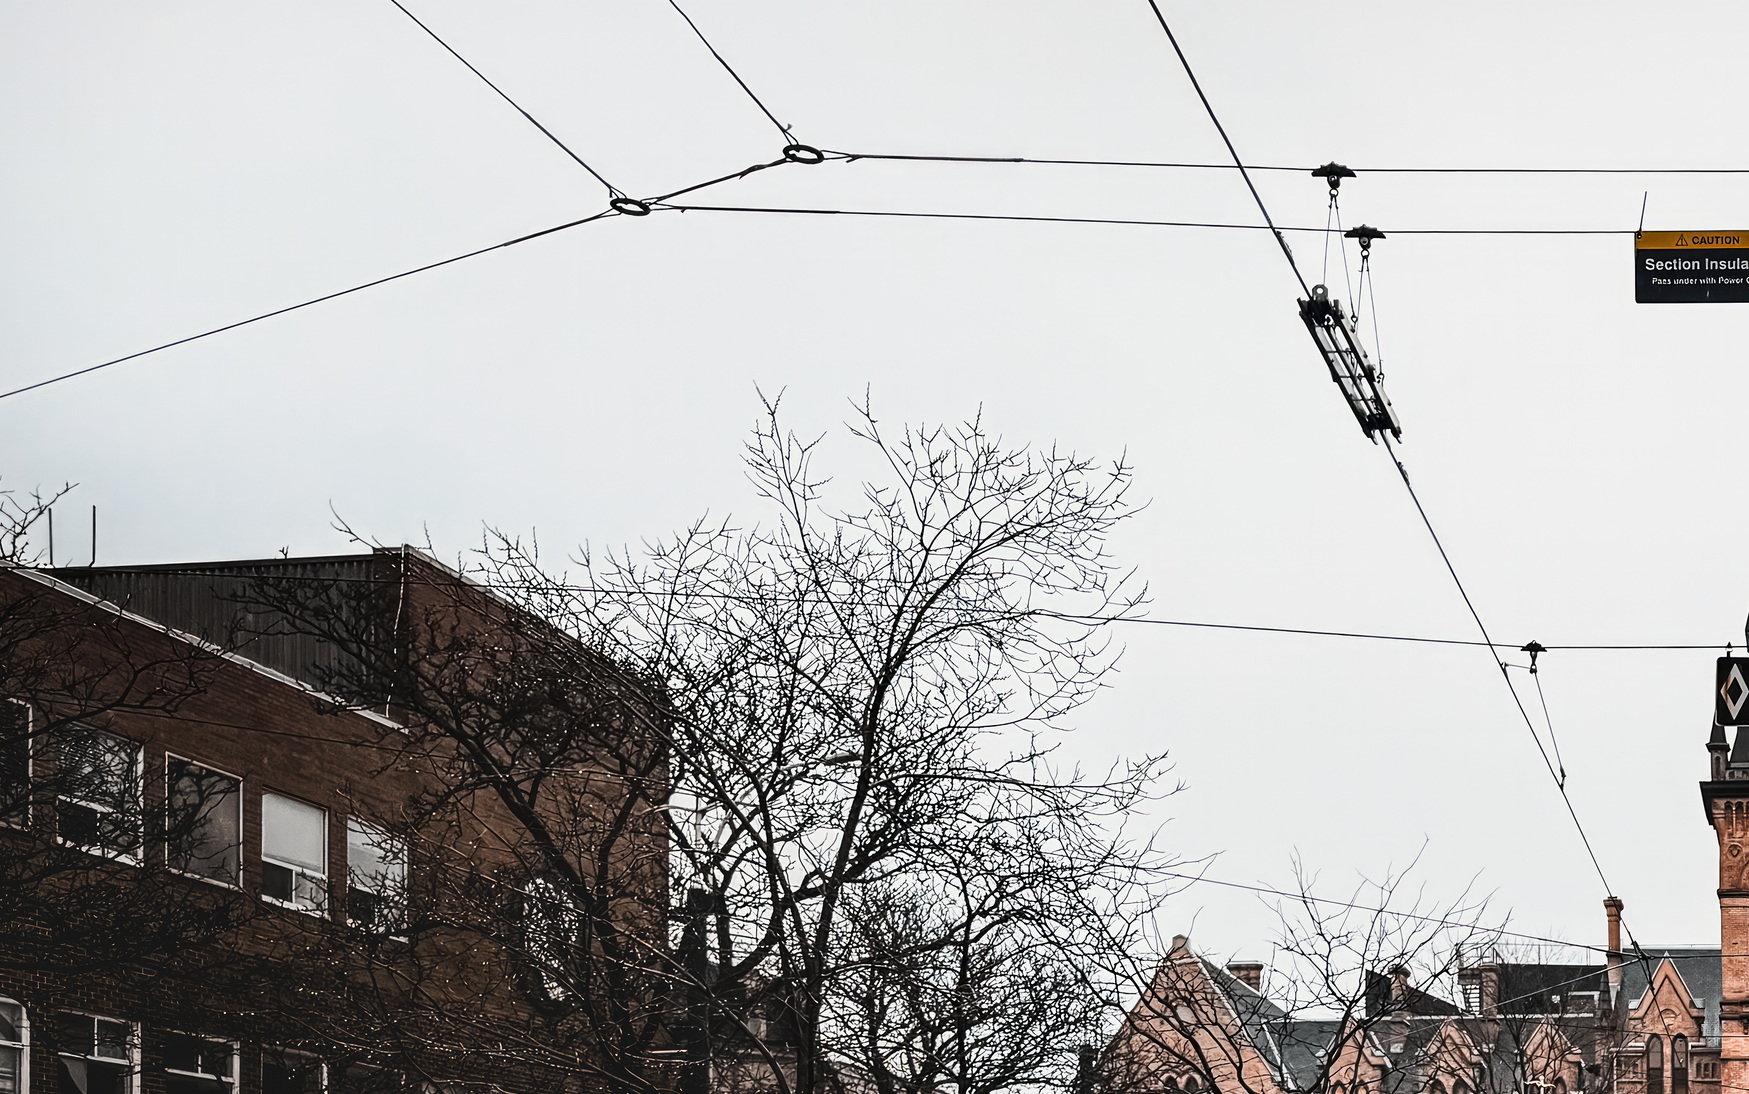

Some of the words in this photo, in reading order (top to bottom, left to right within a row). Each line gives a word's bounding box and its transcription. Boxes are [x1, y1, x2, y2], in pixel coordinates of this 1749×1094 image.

[1691, 235, 1740, 245] CAUTION
[1645, 258, 1700, 271] Section
[1652, 277, 1671, 285] Pass
[1673, 277, 1698, 285] under
[1699, 276, 1716, 284] with
[1718, 276, 1743, 284] Power
